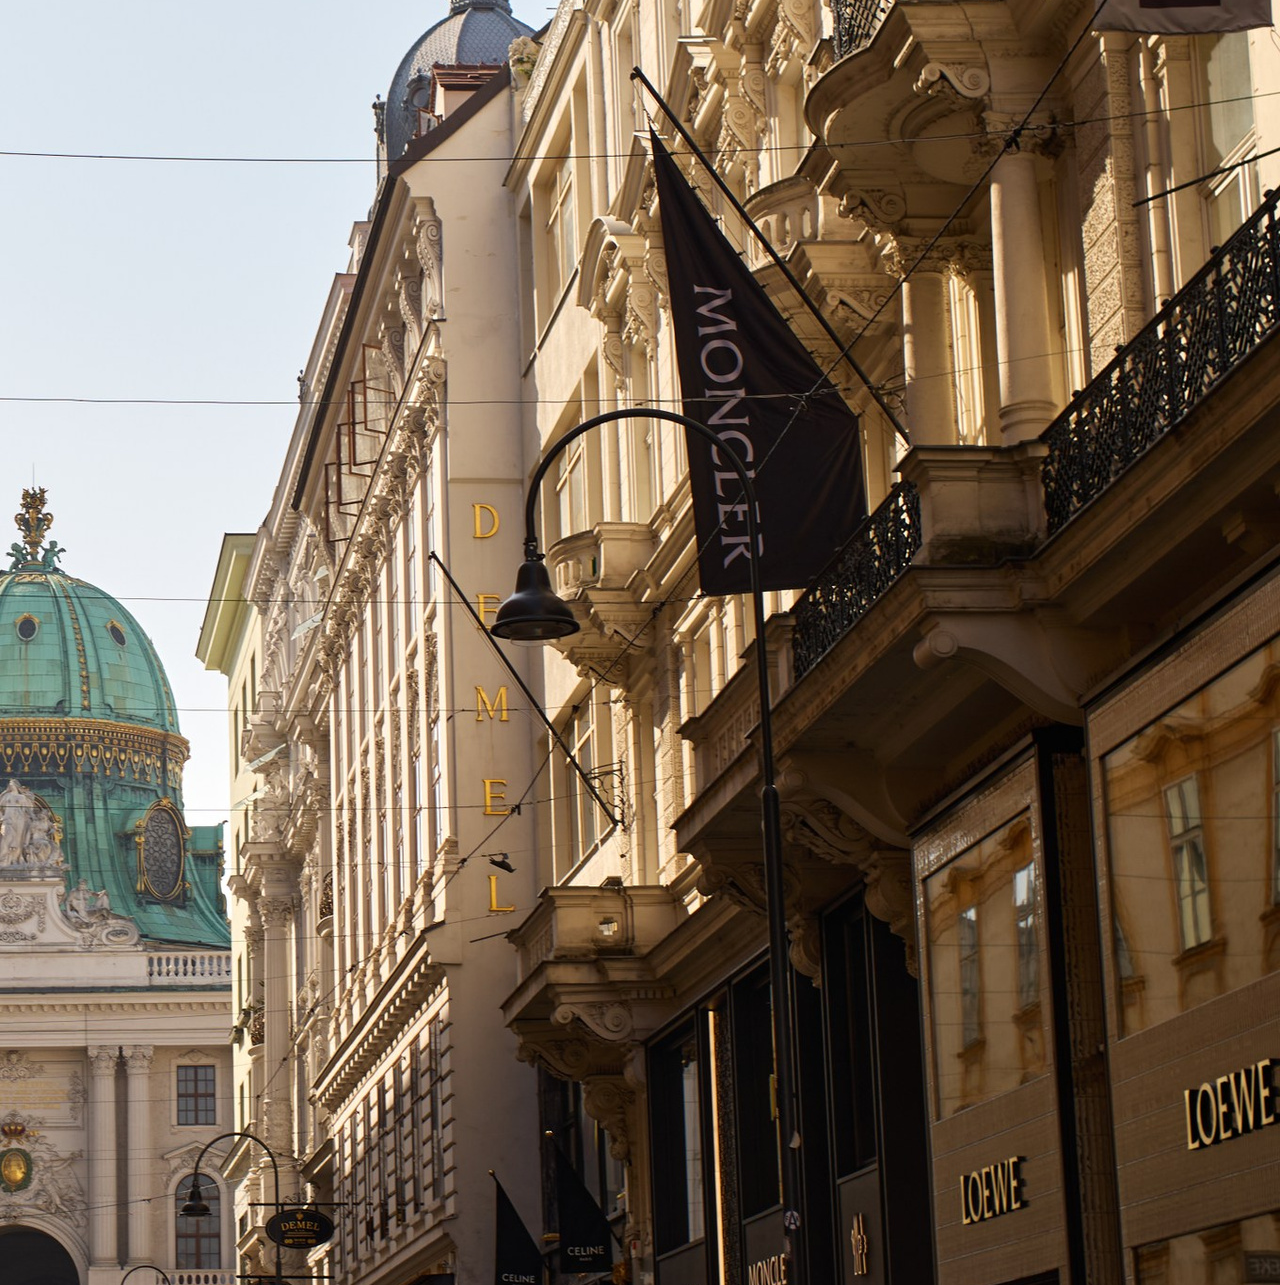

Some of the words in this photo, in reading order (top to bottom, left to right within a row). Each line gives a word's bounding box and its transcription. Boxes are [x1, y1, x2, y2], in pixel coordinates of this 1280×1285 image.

[693, 282, 764, 571] MONCLER
[1184, 1058, 1275, 1150] LOEWE
[960, 1156, 1022, 1225] LOEWE
[280, 1220, 320, 1232] DEMEL
[566, 1245, 606, 1256] CELINE
[501, 1273, 536, 1284] CELINE
